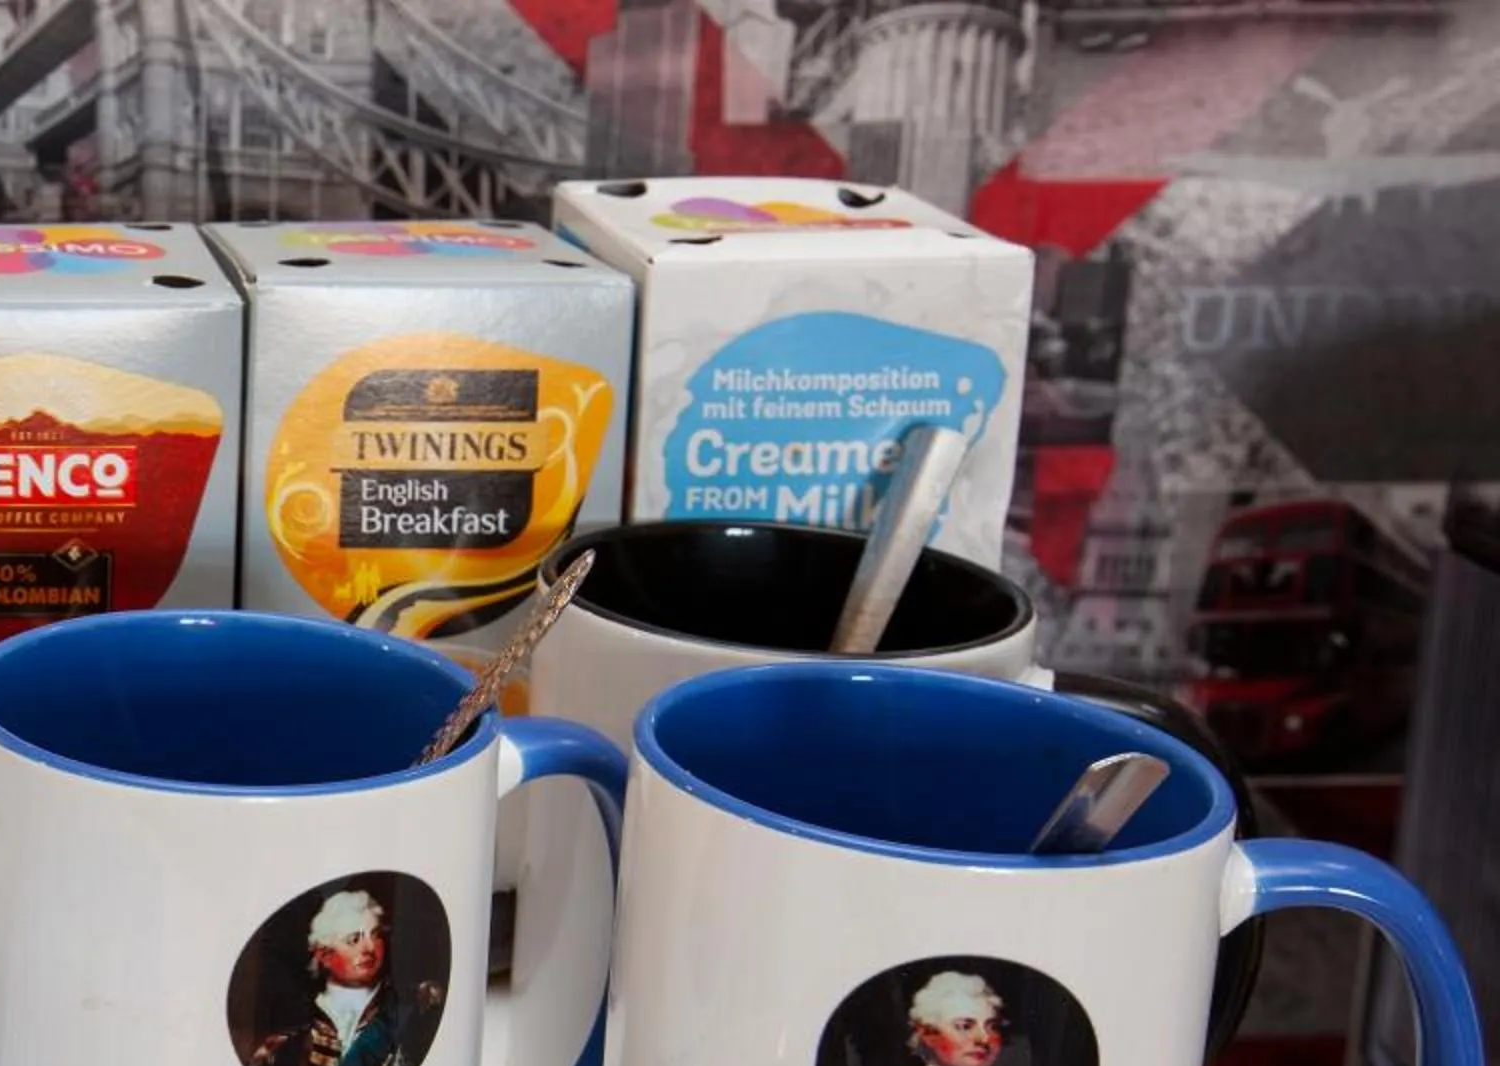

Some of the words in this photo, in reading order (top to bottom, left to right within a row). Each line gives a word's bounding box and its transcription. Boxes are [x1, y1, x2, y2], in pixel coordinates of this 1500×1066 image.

[712, 367, 940, 396] Milchkomposition
[702, 396, 746, 419] mit
[753, 395, 842, 419] feinem
[847, 395, 952, 418] Schaum
[352, 430, 529, 462] TWININGS
[360, 478, 449, 508] English
[685, 485, 768, 511] FROM
[49, 510, 127, 525] COMPANY
[360, 504, 511, 536] Breakfast
